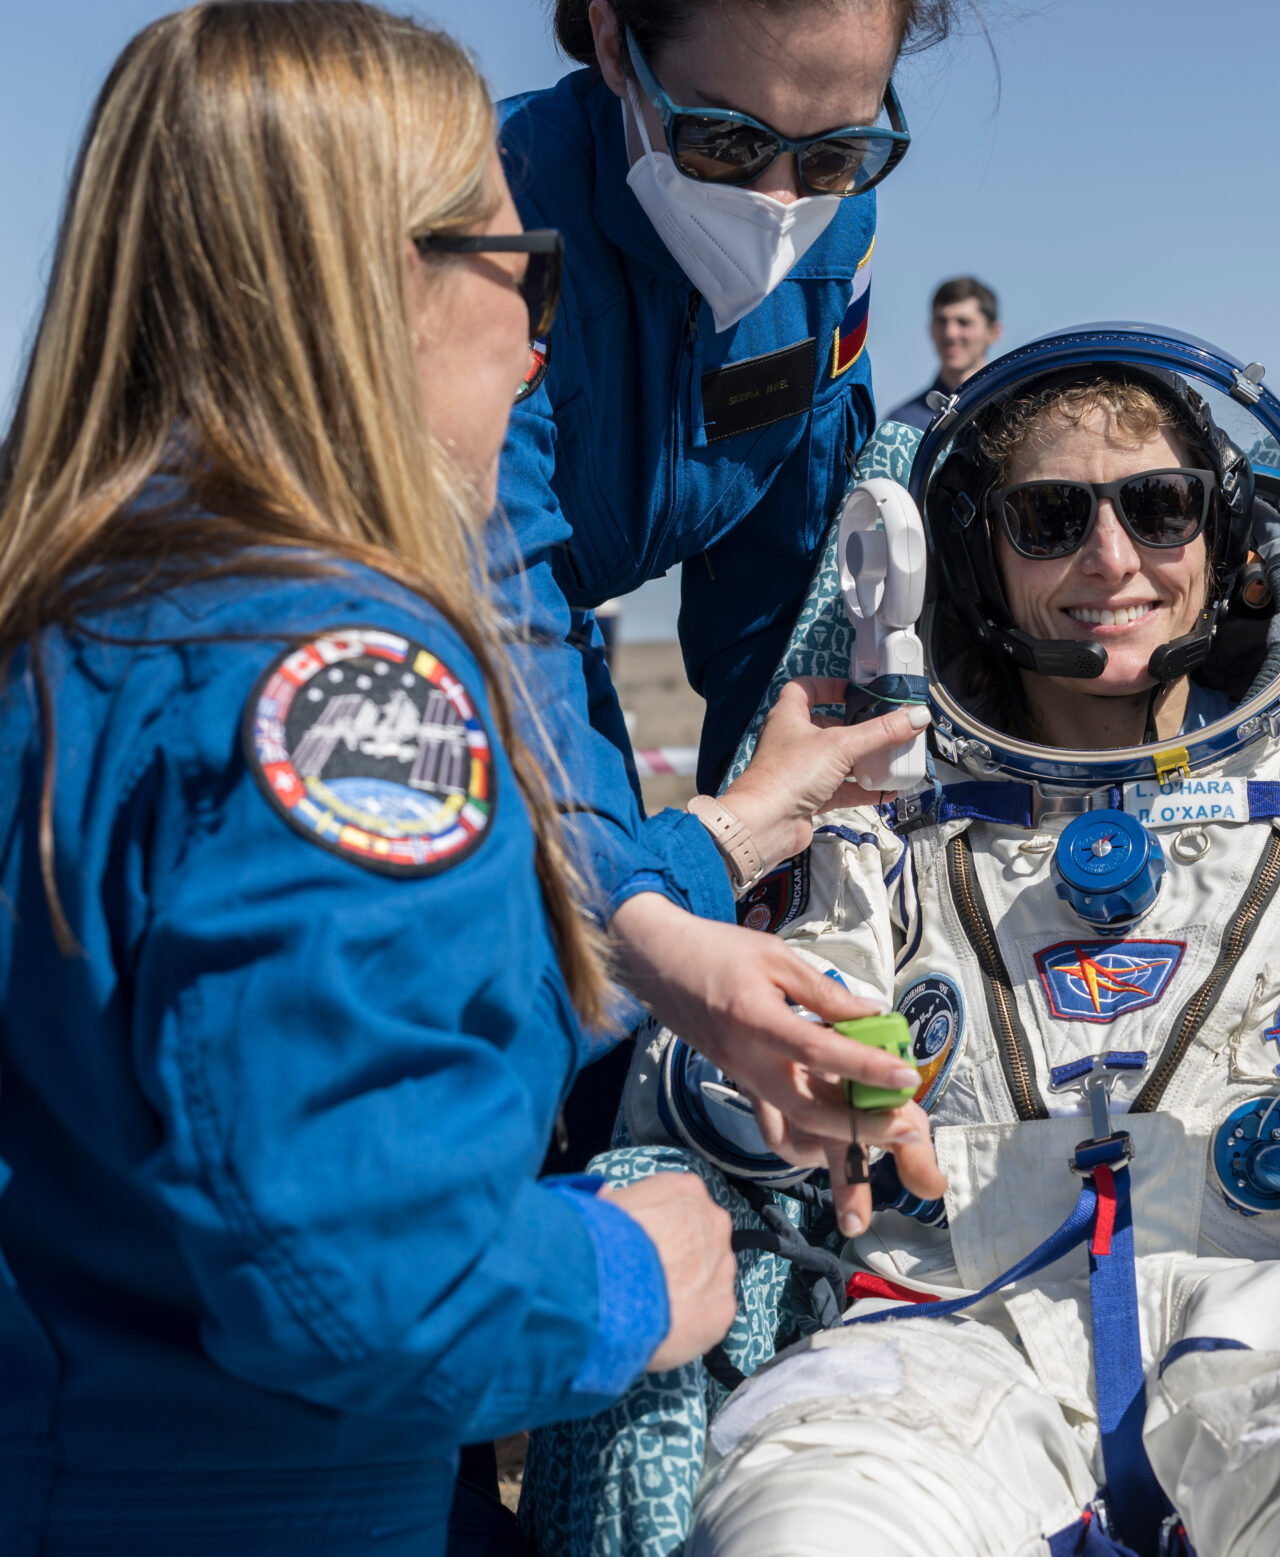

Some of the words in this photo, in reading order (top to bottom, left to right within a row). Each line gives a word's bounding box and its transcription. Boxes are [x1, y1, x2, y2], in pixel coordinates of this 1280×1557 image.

[1136, 783, 1154, 798] L.
[1159, 780, 1234, 796] O'HARA
[1161, 804, 1235, 822] О'ХАРА
